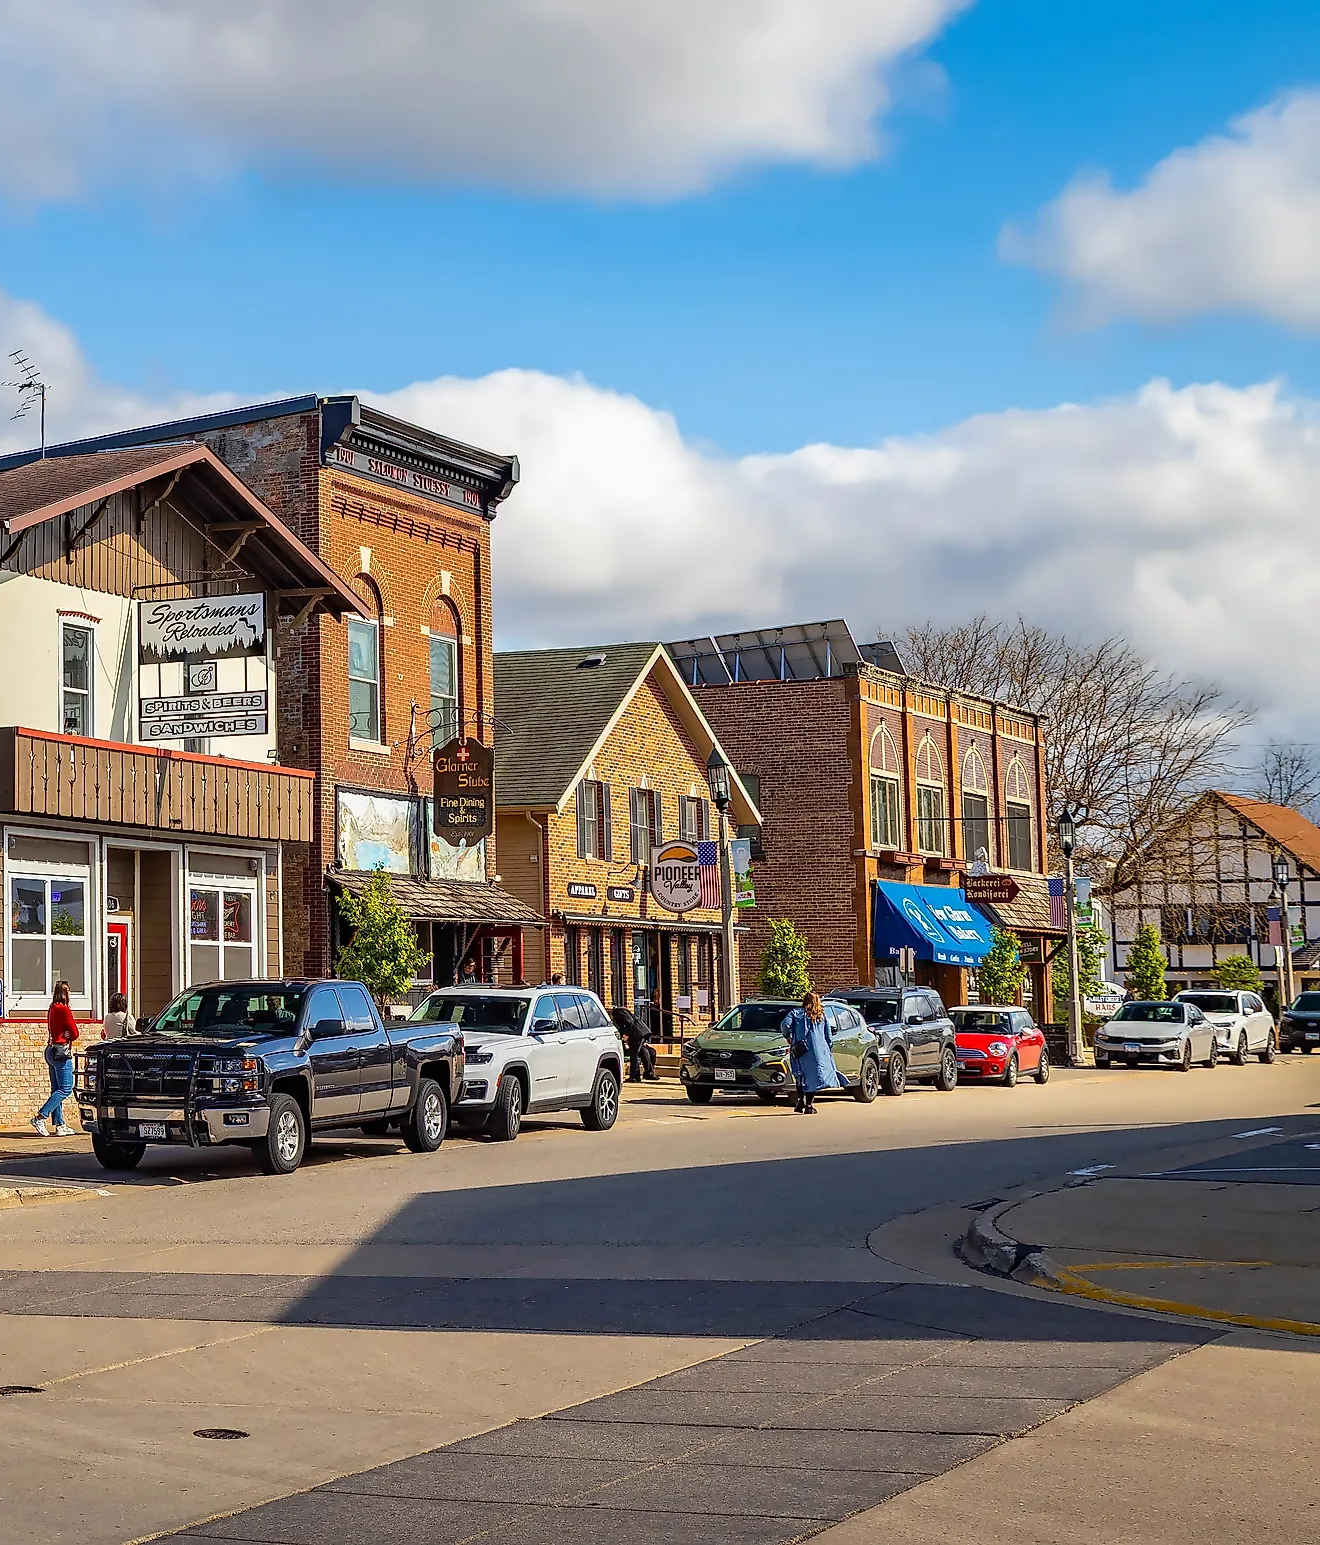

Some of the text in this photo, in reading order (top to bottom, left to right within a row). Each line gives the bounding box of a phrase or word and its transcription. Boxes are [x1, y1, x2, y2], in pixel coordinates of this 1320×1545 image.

[338, 447, 355, 466] 1901
[413, 473, 452, 497] STUESSY
[463, 490, 481, 506] 1901
[146, 602, 261, 630] Sportsmans
[162, 620, 239, 643] Reloaded
[145, 695, 262, 714] SPIRITS & BEERS
[149, 718, 258, 736] SANDWICHES
[435, 757, 479, 773] Glarner
[458, 773, 490, 788] Stube
[440, 797, 485, 809] Fine Dining
[448, 813, 478, 824] Spirits
[570, 885, 596, 896] APPAREL
[613, 889, 630, 899] GIFTS
[663, 878, 694, 895] Valley
[658, 892, 700, 908] COUNTRY STORE
